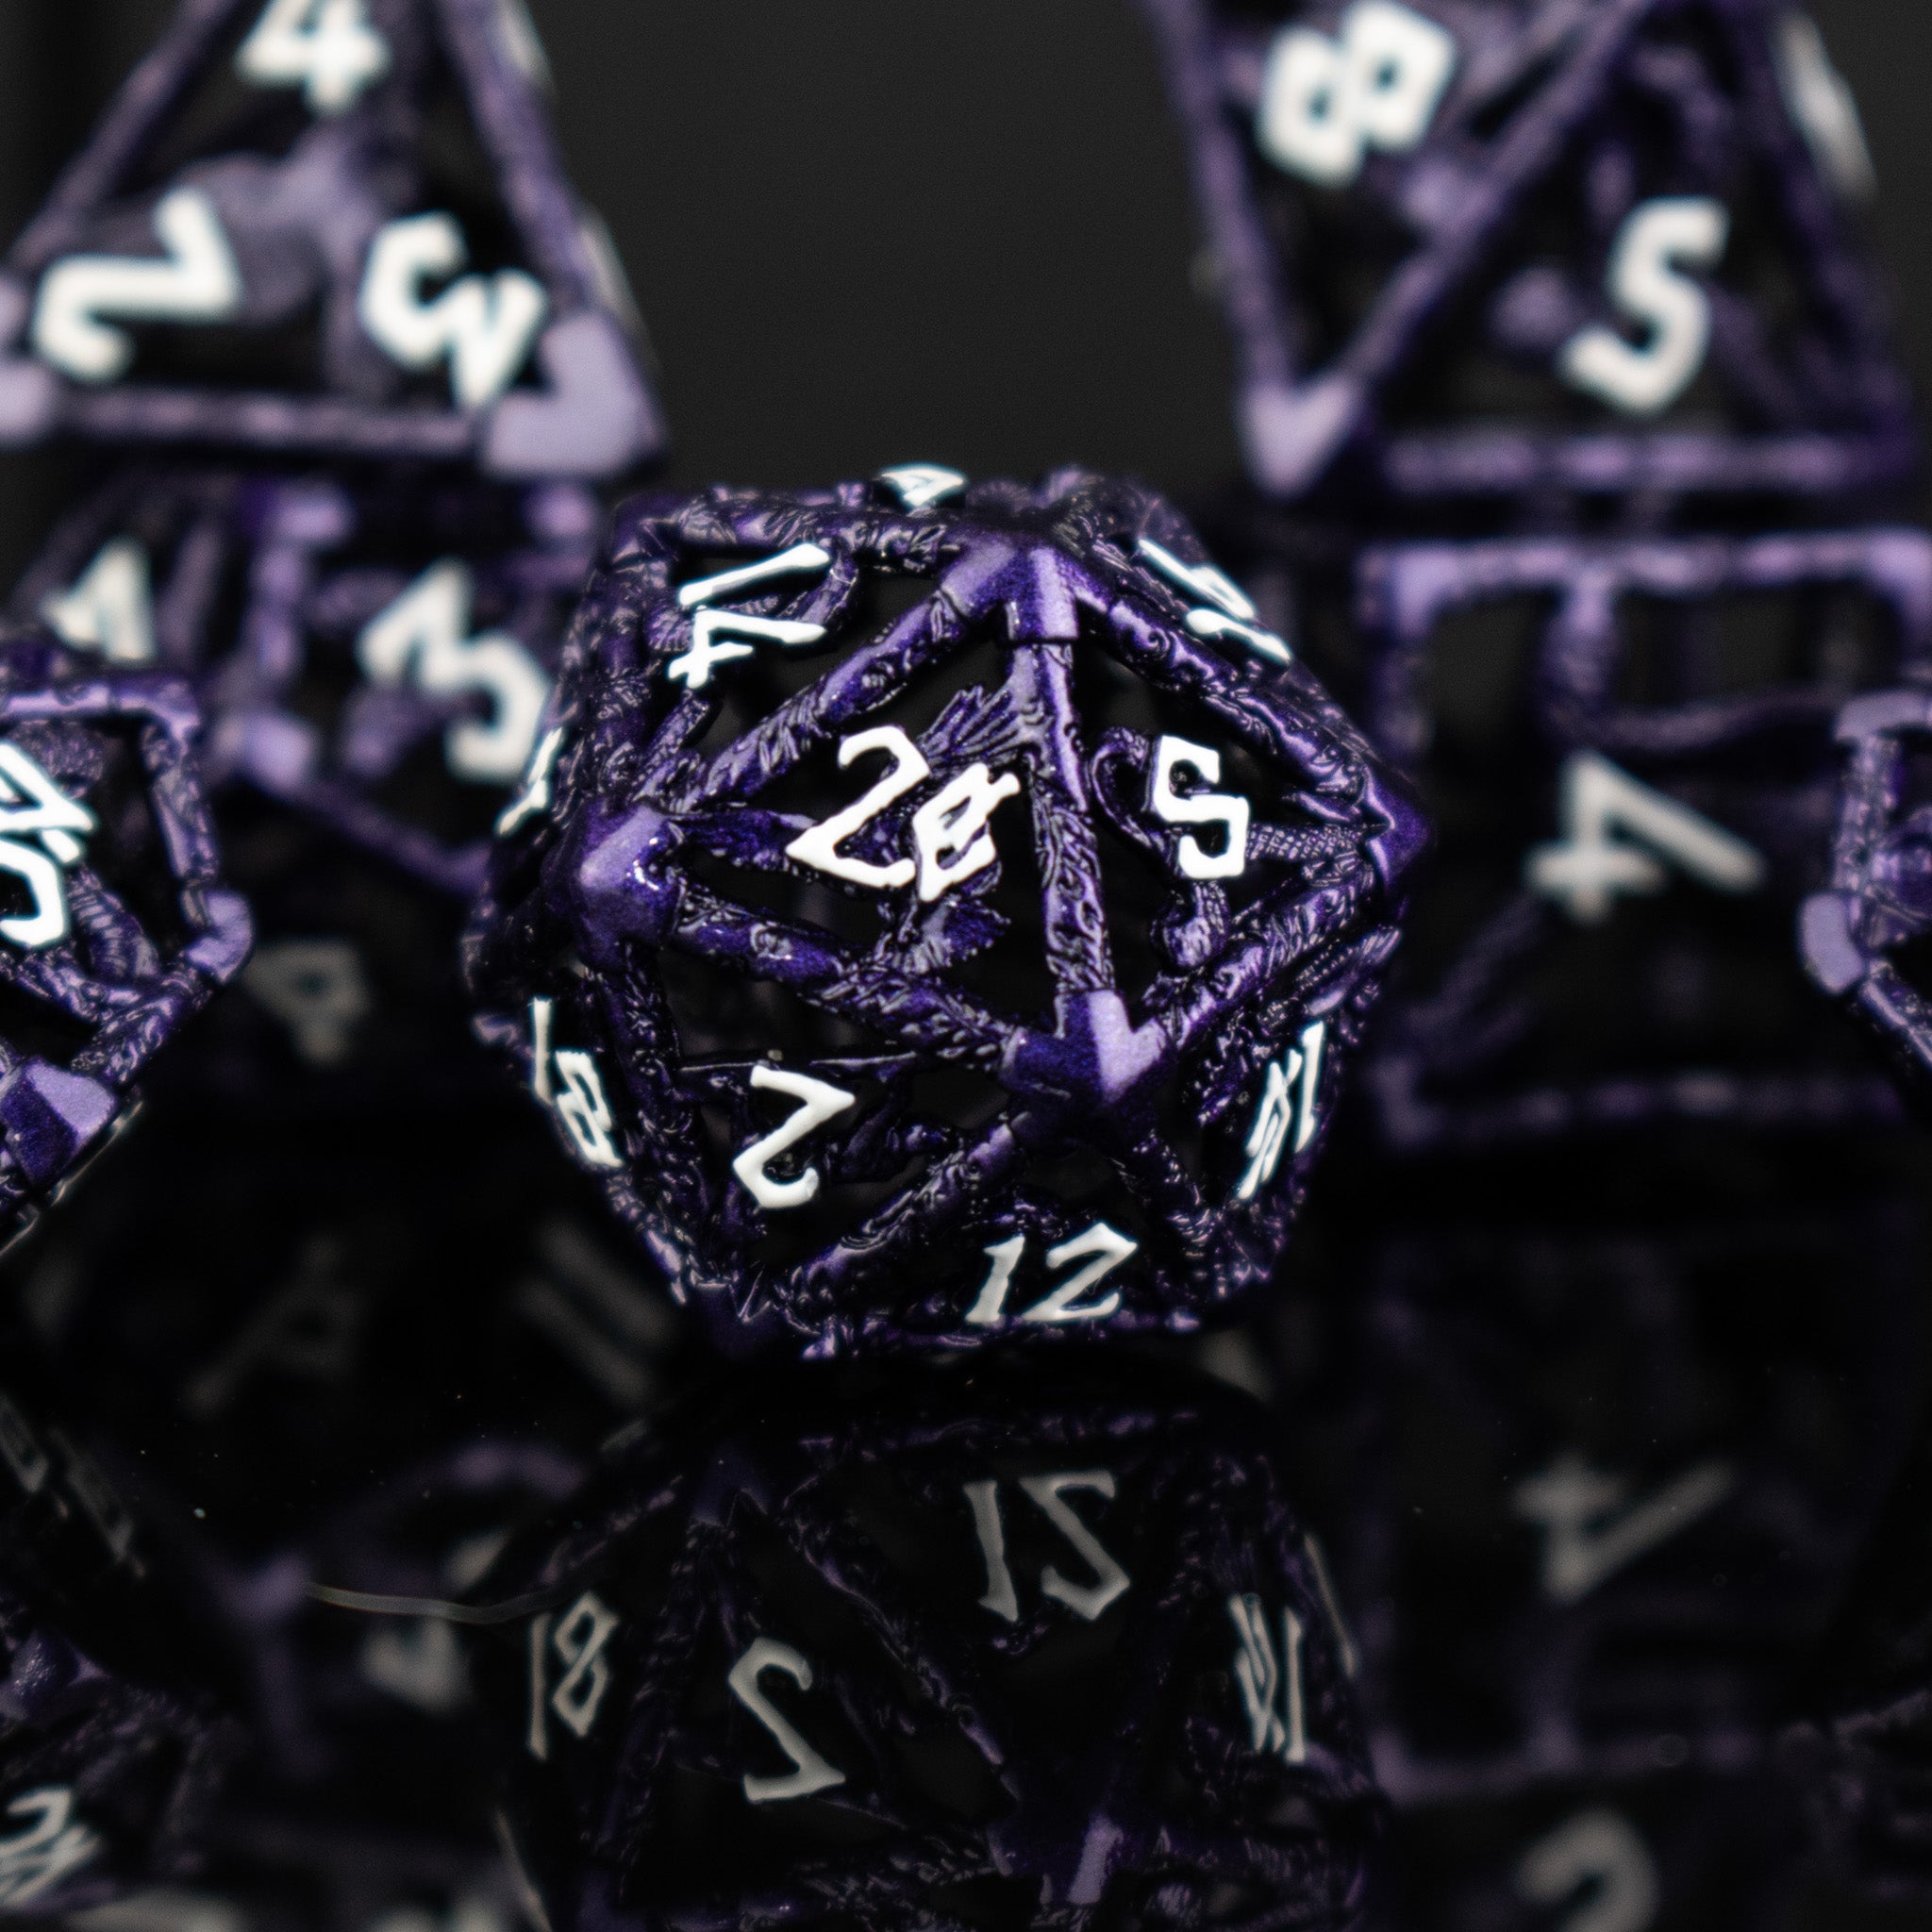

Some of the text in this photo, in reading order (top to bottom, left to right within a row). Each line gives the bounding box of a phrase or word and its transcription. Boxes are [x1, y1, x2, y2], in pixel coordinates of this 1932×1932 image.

[242, 0, 386, 109] 4
[1261, 2, 1455, 181] 8
[360, 220, 542, 408] 3
[1564, 200, 1724, 411] 5
[1530, 754, 1758, 917] 4
[732, 1063, 856, 1208] 2
[966, 1222, 1139, 1324] 12
